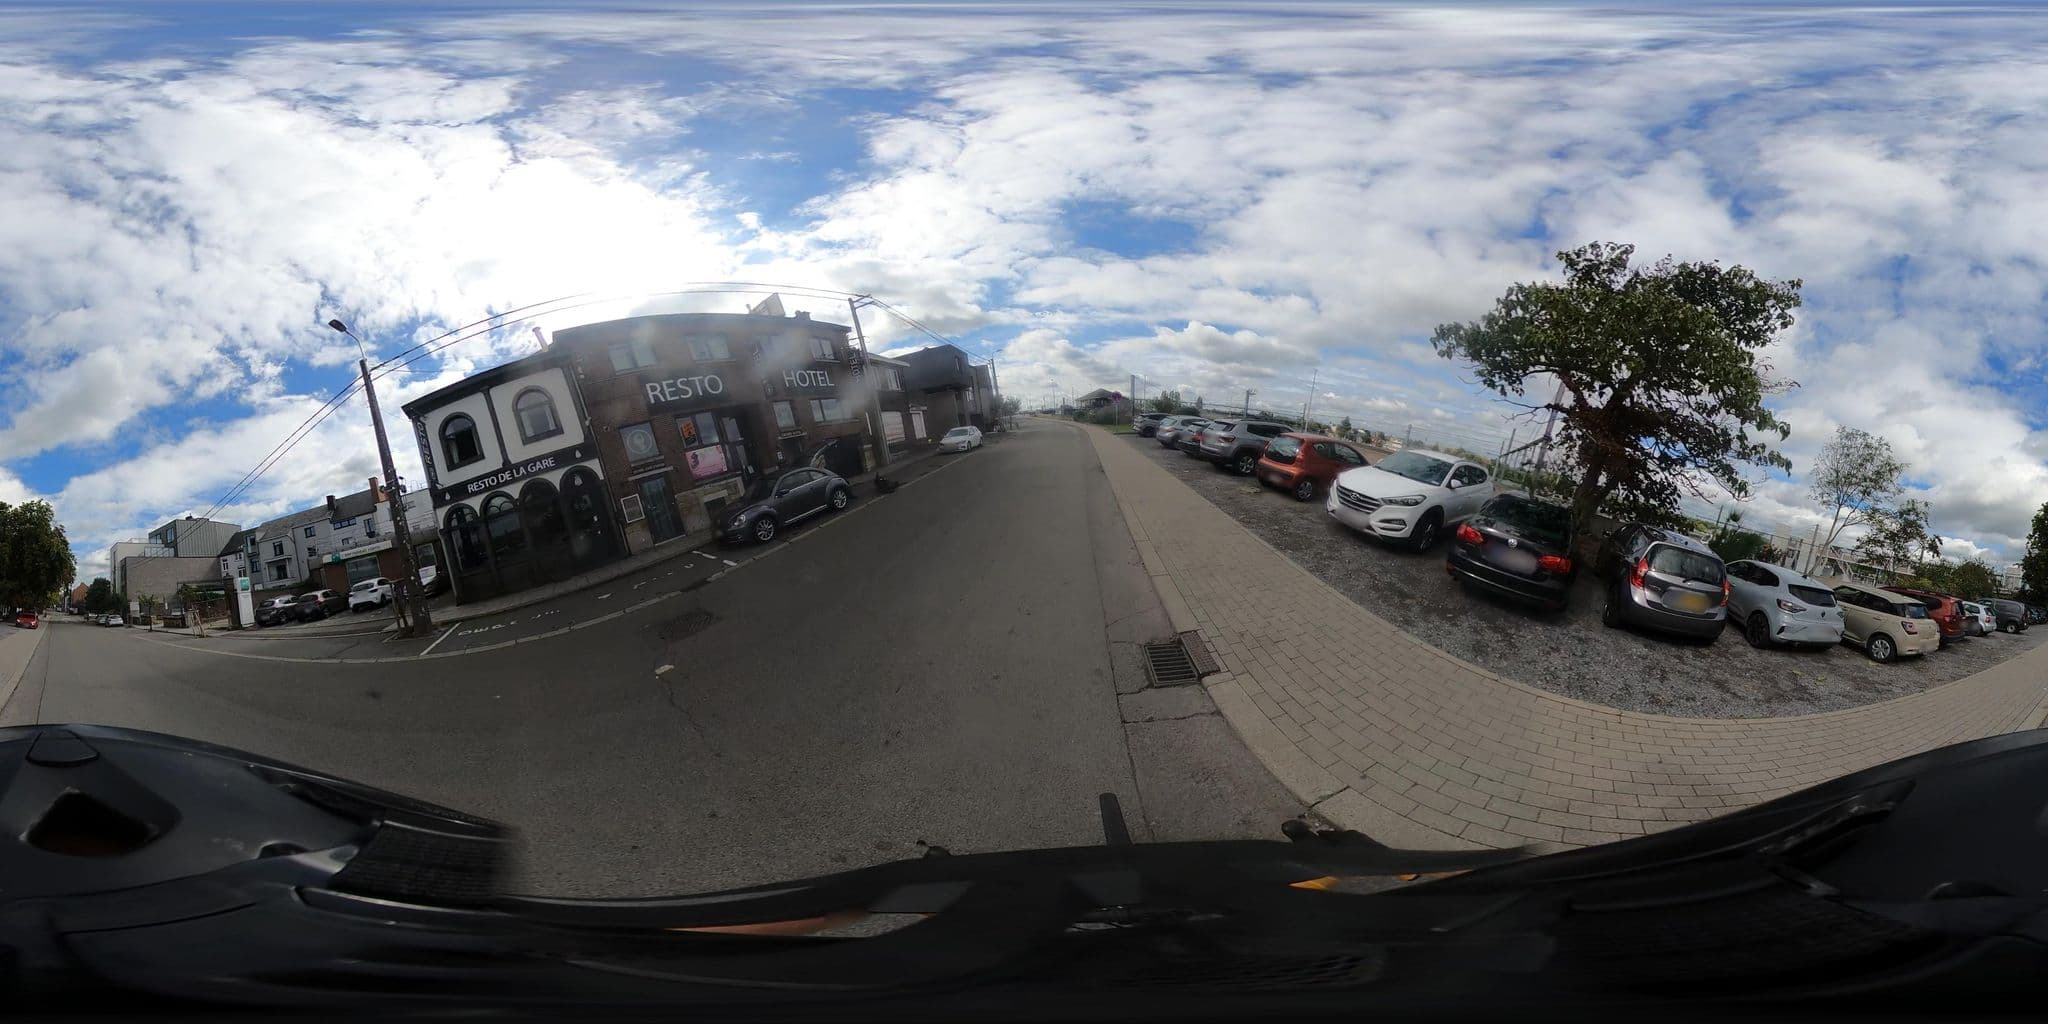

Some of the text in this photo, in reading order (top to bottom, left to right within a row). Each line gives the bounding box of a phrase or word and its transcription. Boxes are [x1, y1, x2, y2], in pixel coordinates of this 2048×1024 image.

[645, 374, 723, 404] RESTO
[782, 370, 834, 387] HOTEL
[467, 457, 556, 494] RESTO DE LA GARE
